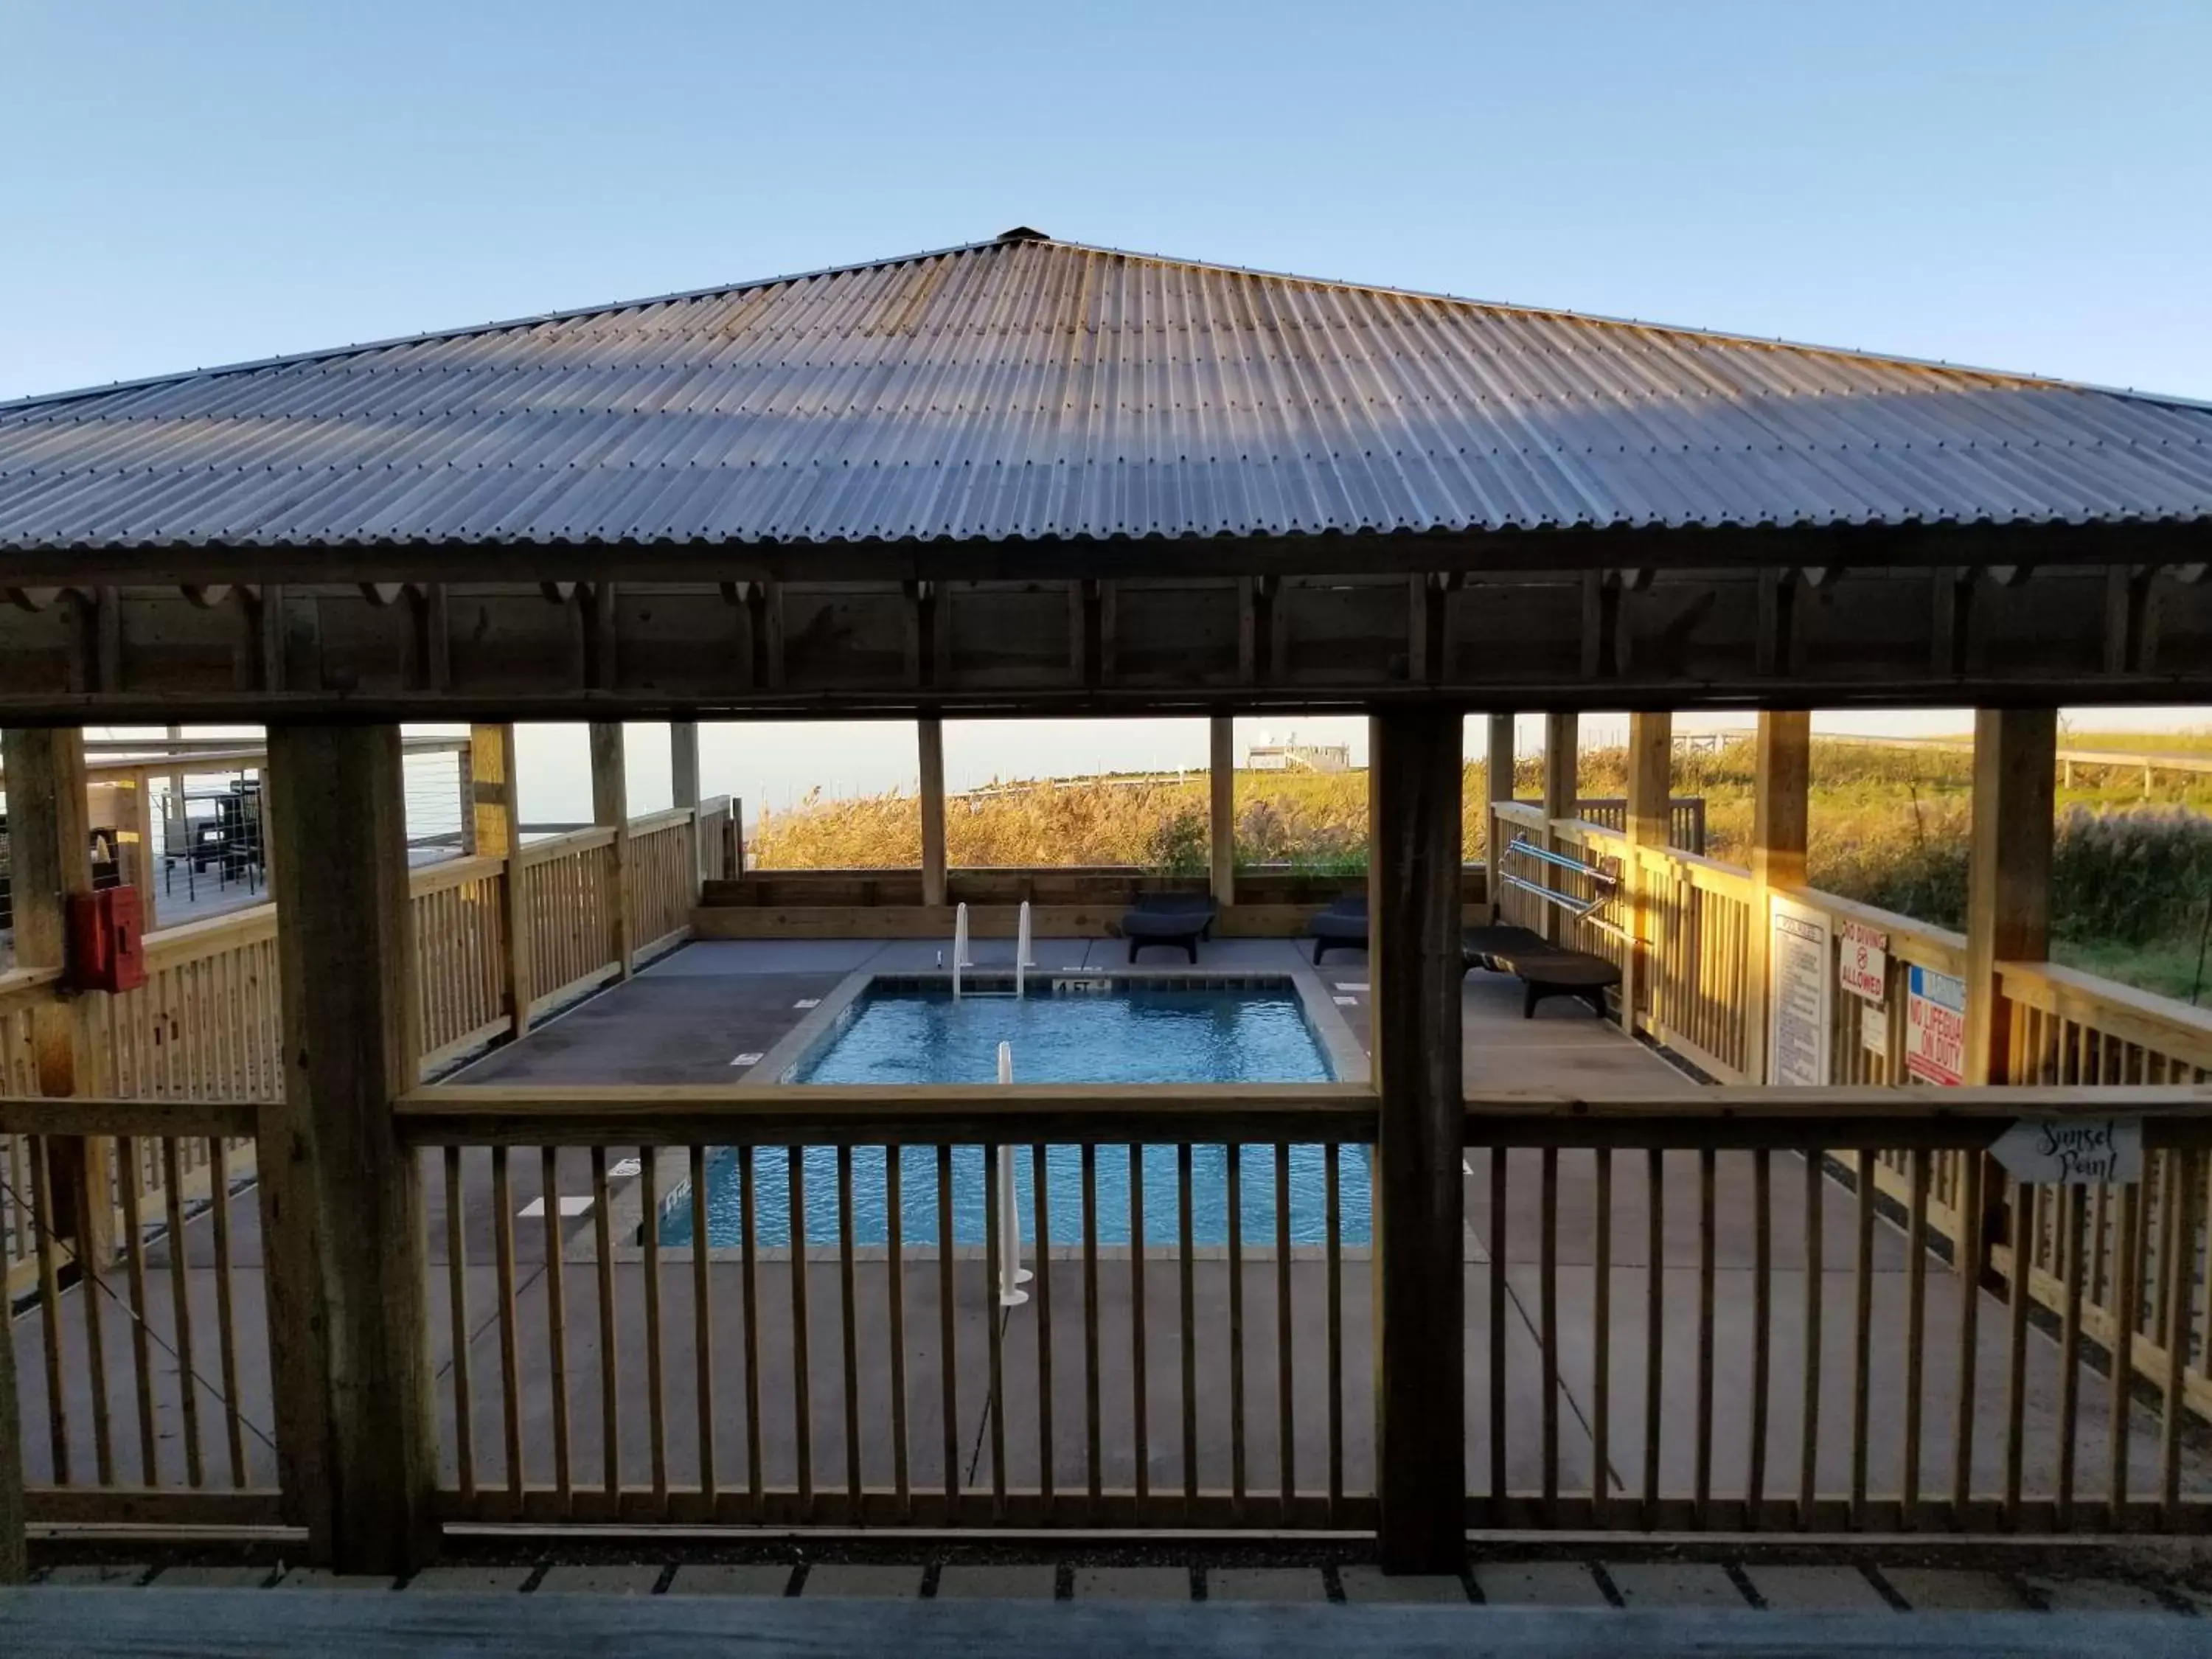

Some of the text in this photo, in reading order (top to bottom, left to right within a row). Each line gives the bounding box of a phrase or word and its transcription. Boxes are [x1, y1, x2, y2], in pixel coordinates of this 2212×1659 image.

[1842, 919, 1854, 941] NO
[1857, 925, 1885, 950] DIVING
[1843, 964, 1881, 995] ALLOWED
[1910, 997, 1922, 1026] NO
[1924, 1004, 1963, 1043] LIFEGUA
[1922, 1029, 1934, 1060] ON
[1936, 1036, 1961, 1074] DUTY
[2037, 1119, 2115, 1156] Sunset
[2058, 1149, 2118, 1183] Point
